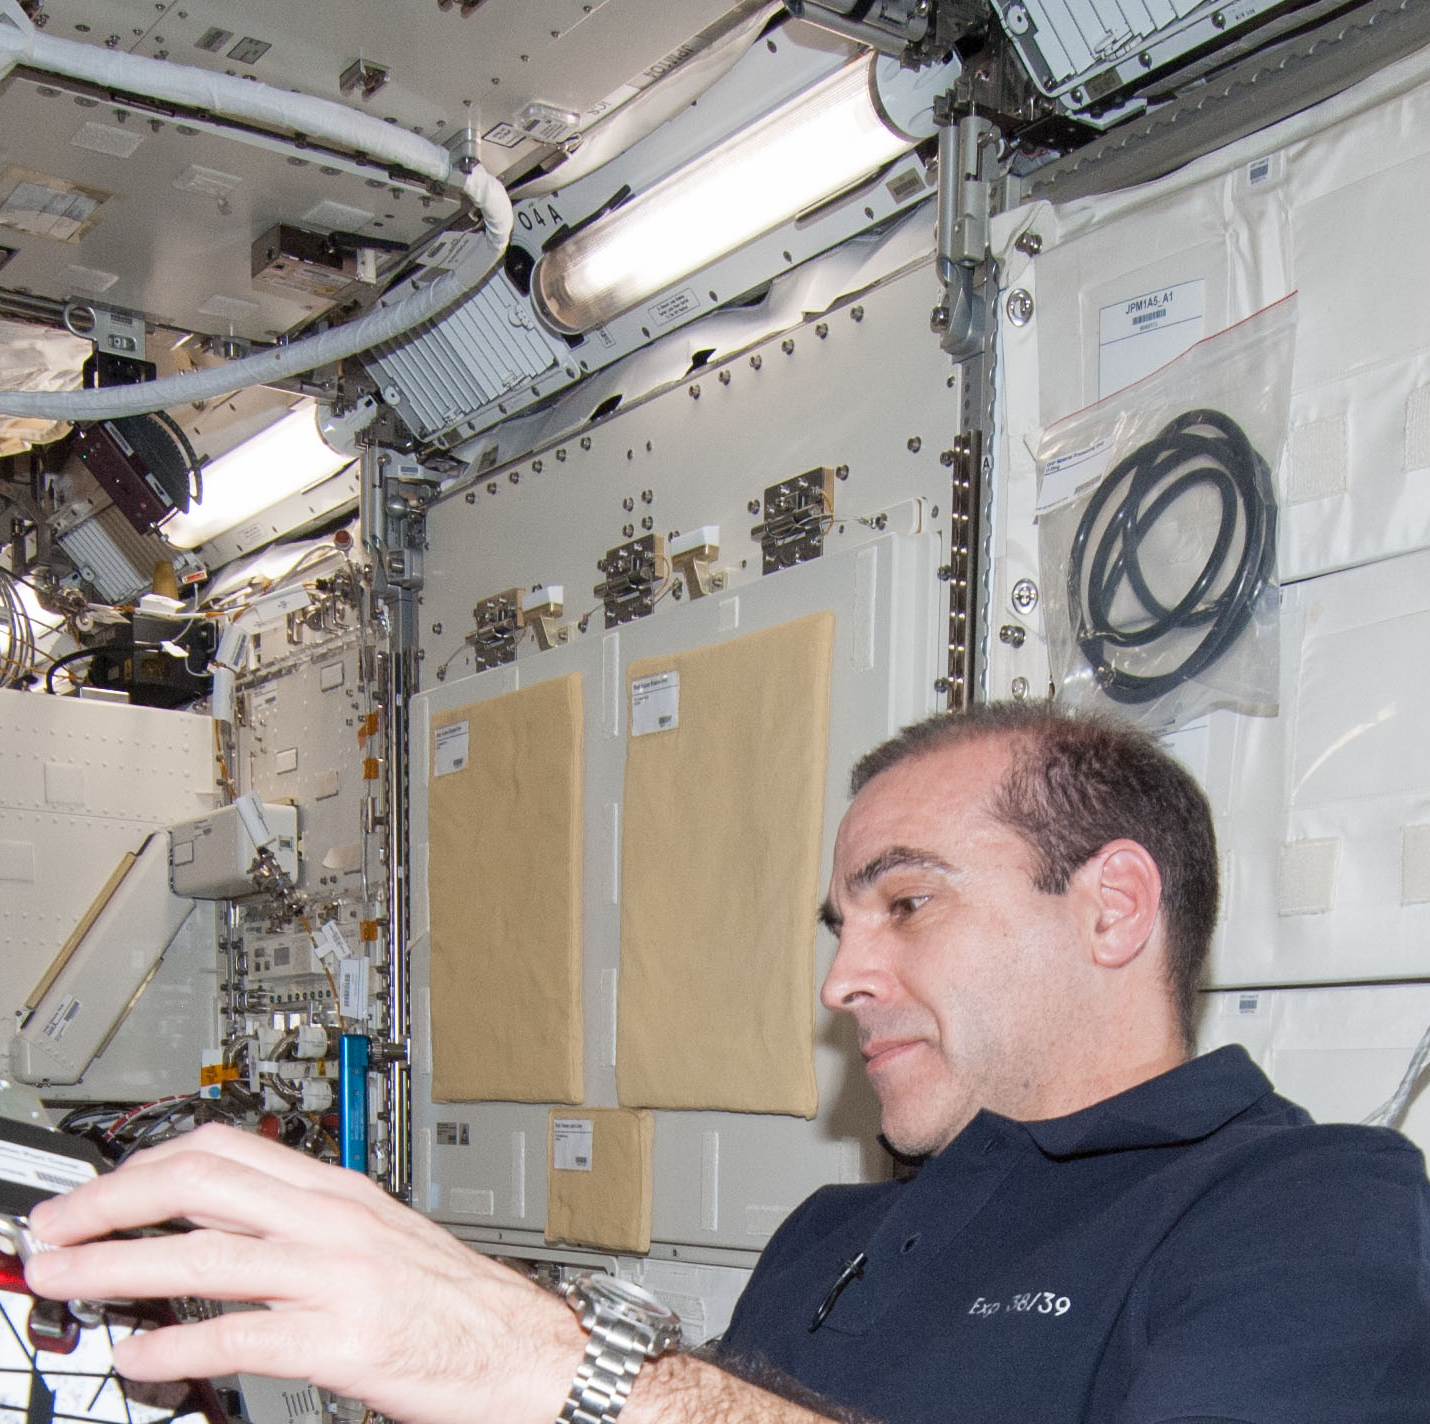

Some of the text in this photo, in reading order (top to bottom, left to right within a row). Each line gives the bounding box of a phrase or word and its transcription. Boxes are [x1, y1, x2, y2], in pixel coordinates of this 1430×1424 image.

[1126, 291, 1173, 314] JPM1A5_A1
[968, 1291, 1071, 1318] Exp 38/39
